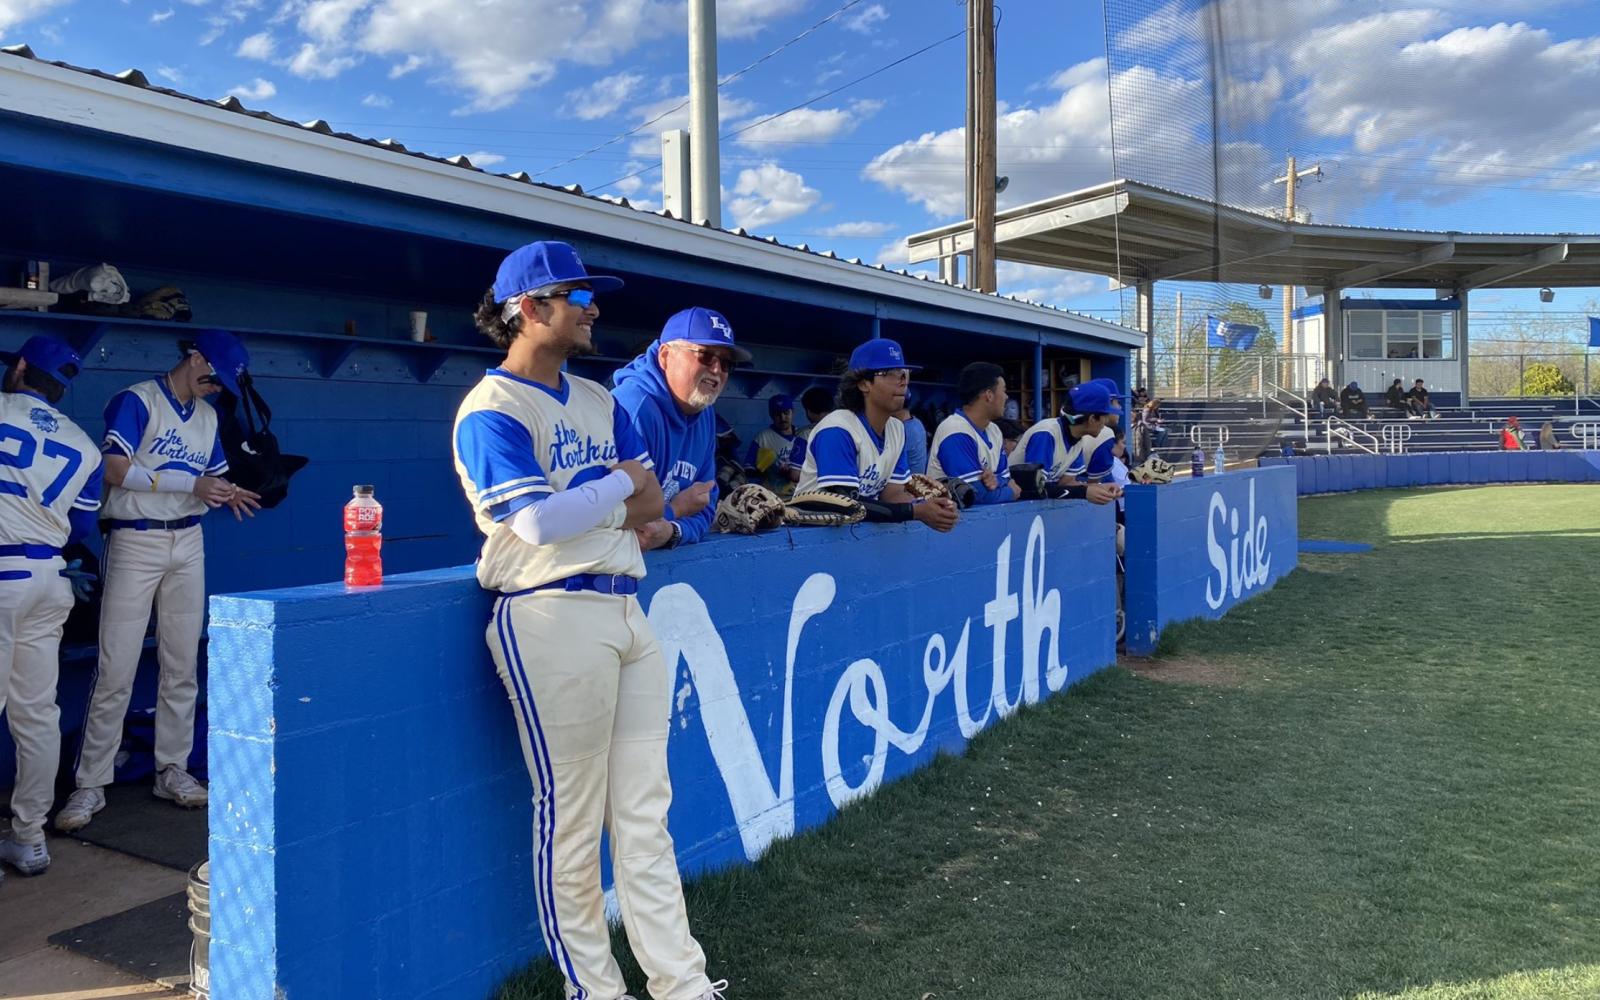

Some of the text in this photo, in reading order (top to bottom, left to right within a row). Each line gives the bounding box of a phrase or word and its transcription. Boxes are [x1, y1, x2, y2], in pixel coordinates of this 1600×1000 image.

[165, 428, 183, 446] the
[554, 418, 580, 447] the
[0, 422, 83, 508] 27
[602, 477, 1272, 921] North Side
